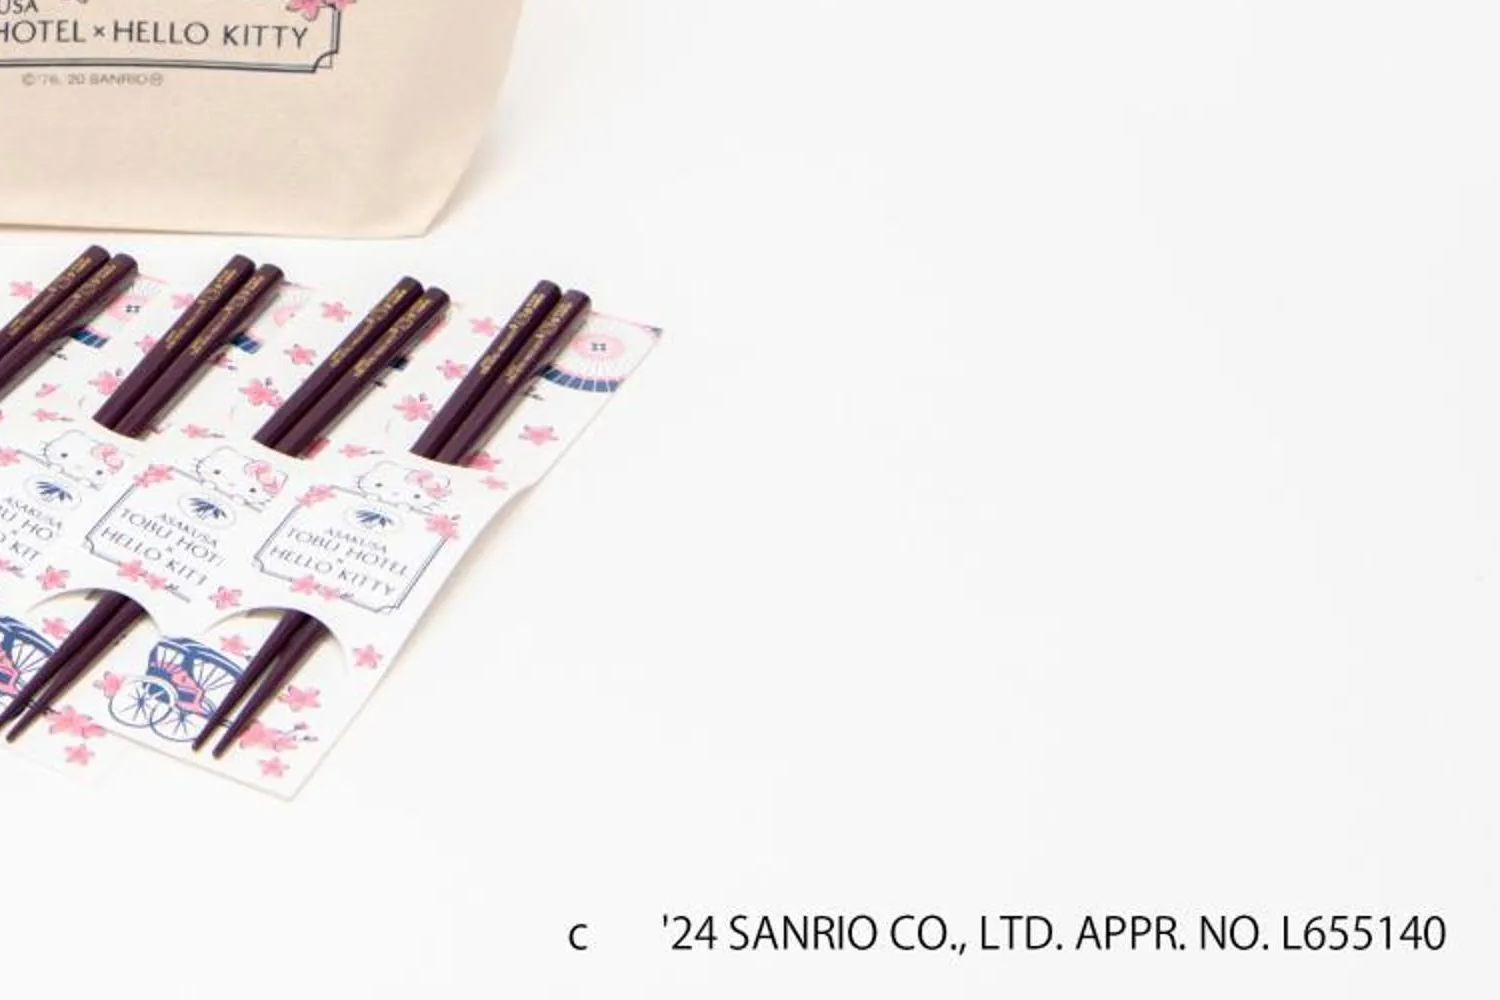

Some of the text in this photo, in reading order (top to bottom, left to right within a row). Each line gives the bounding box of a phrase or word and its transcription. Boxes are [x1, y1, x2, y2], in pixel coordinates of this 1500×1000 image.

[113, 20, 209, 45] HELLO
[223, 23, 308, 49] KITTY
[120, 508, 173, 538] TOBU
[9, 540, 41, 561] KIT
[101, 526, 161, 561] HELLO
[288, 527, 408, 577] TOBU HOTEL
[270, 546, 395, 596] HELLO KITTY
